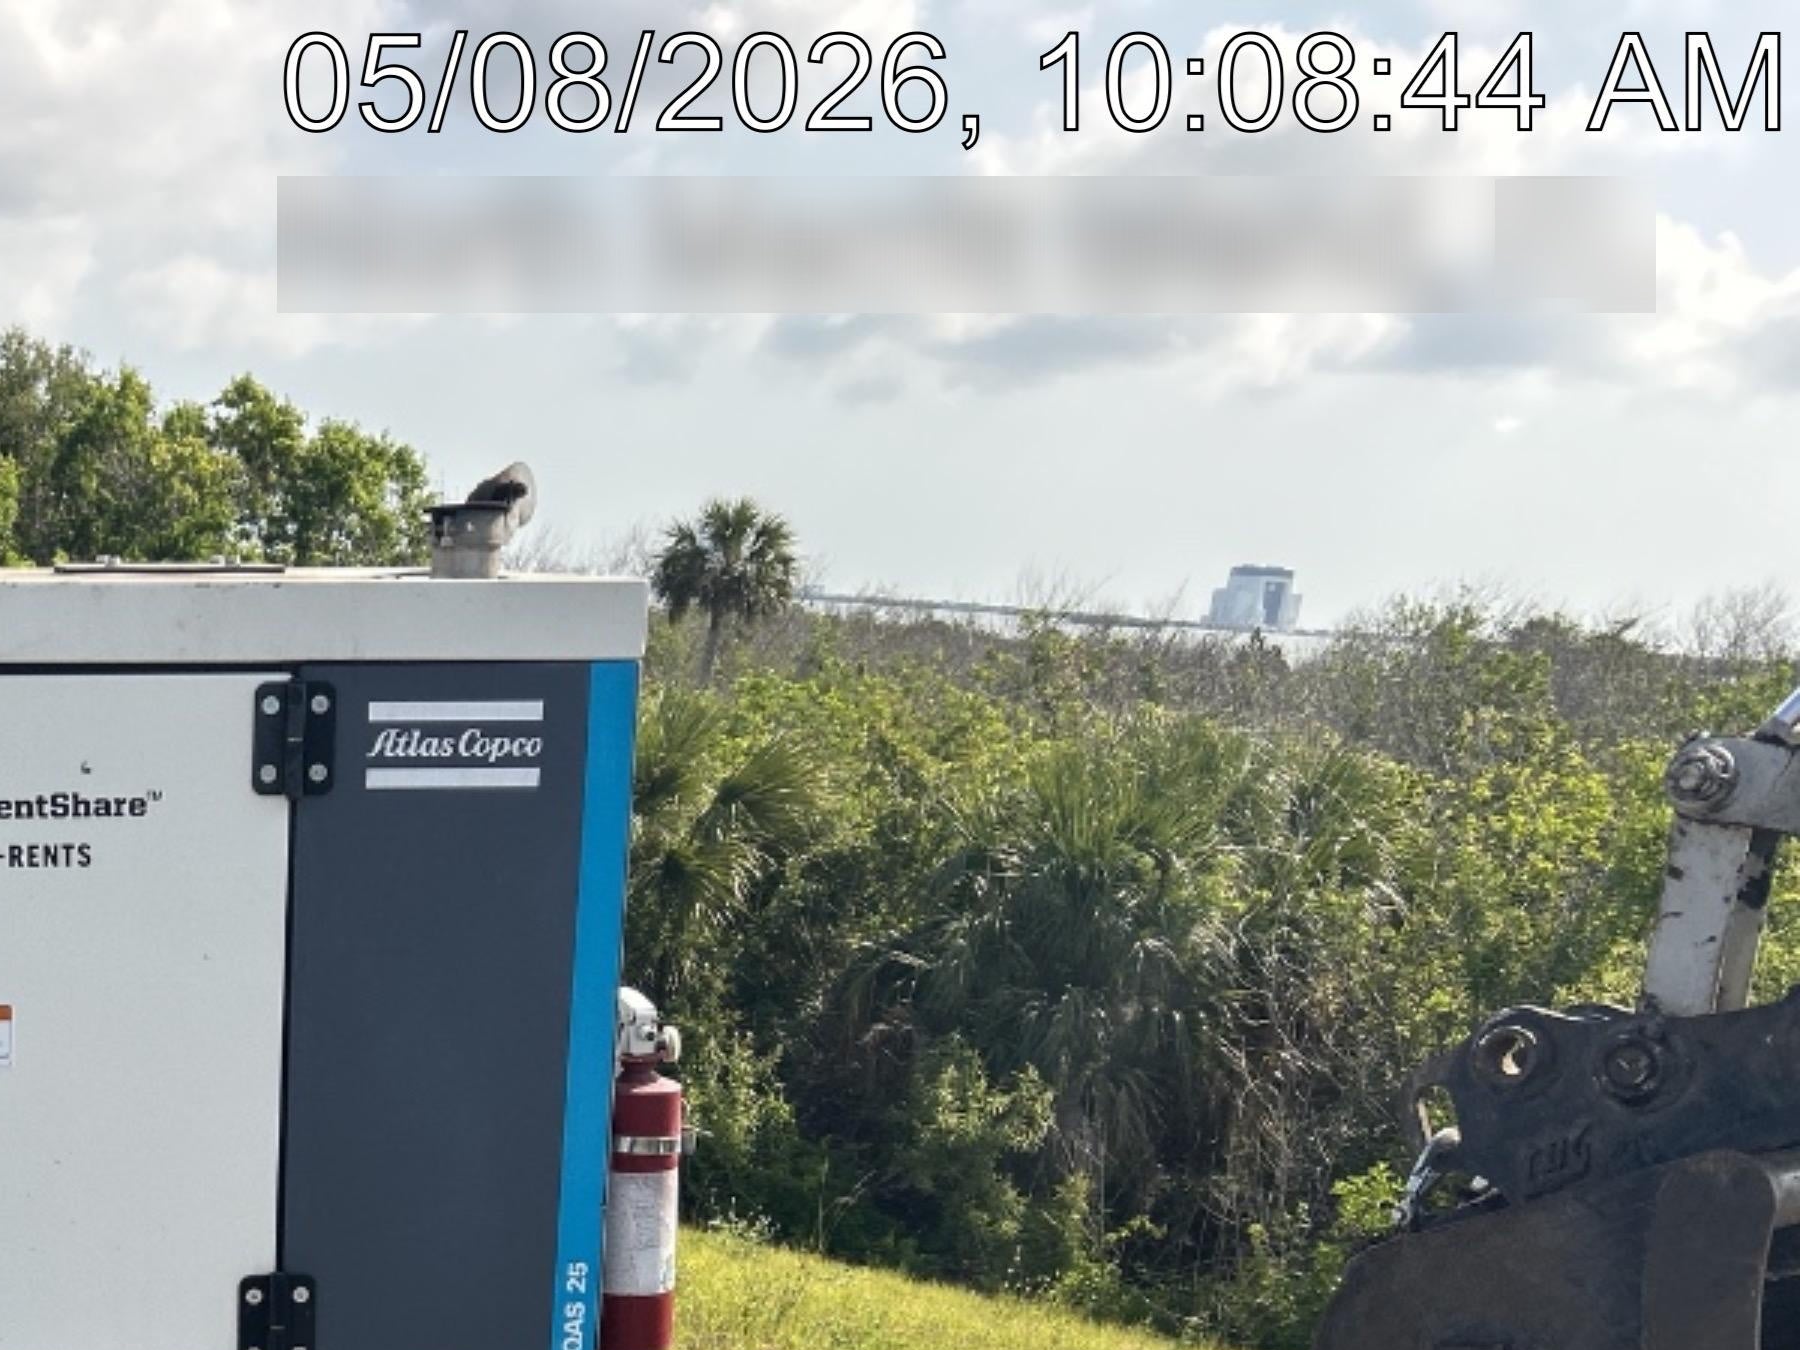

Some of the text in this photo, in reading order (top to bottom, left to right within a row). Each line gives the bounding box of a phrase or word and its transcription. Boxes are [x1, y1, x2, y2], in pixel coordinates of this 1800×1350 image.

[366, 728, 543, 763] Atlas Copco
[566, 1262, 588, 1294] 25
